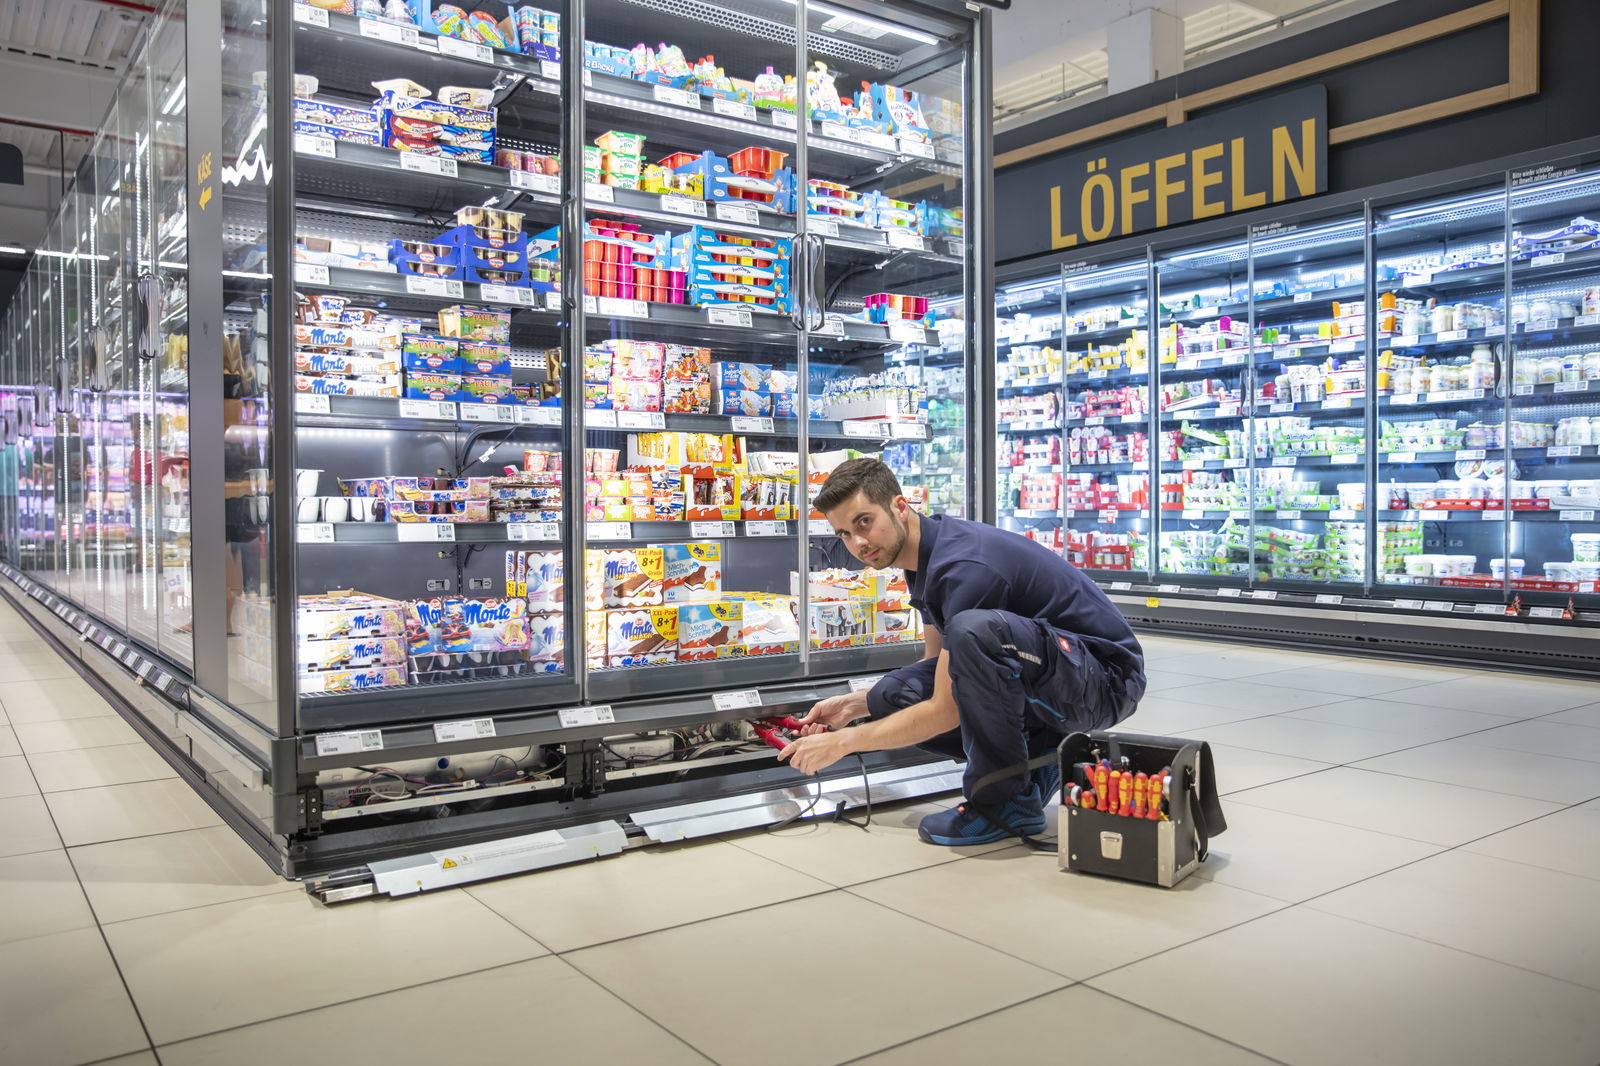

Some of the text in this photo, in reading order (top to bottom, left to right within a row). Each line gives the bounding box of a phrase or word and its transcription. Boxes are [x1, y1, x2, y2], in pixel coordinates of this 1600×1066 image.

[198, 152, 211, 186] KÄSE
[1050, 118, 1316, 249] LÖFFELN
[322, 300, 342, 311] Monte
[343, 313, 361, 323] Monte
[474, 314, 498, 323] PAULA
[310, 329, 346, 345] Monte
[418, 342, 445, 350] PAULA
[310, 355, 345, 371] Monte
[312, 379, 347, 394] Monte
[421, 376, 448, 384] PAULA
[1286, 433, 1316, 442] Almighurt
[606, 560, 637, 578] Monte
[642, 556, 662, 570] 8+1
[465, 604, 510, 625] Monte
[353, 615, 382, 629] Monte
[657, 616, 677, 630] 8+1
[620, 621, 652, 640] Monte
[354, 644, 382, 658] Monte
[355, 673, 384, 688] Monte
